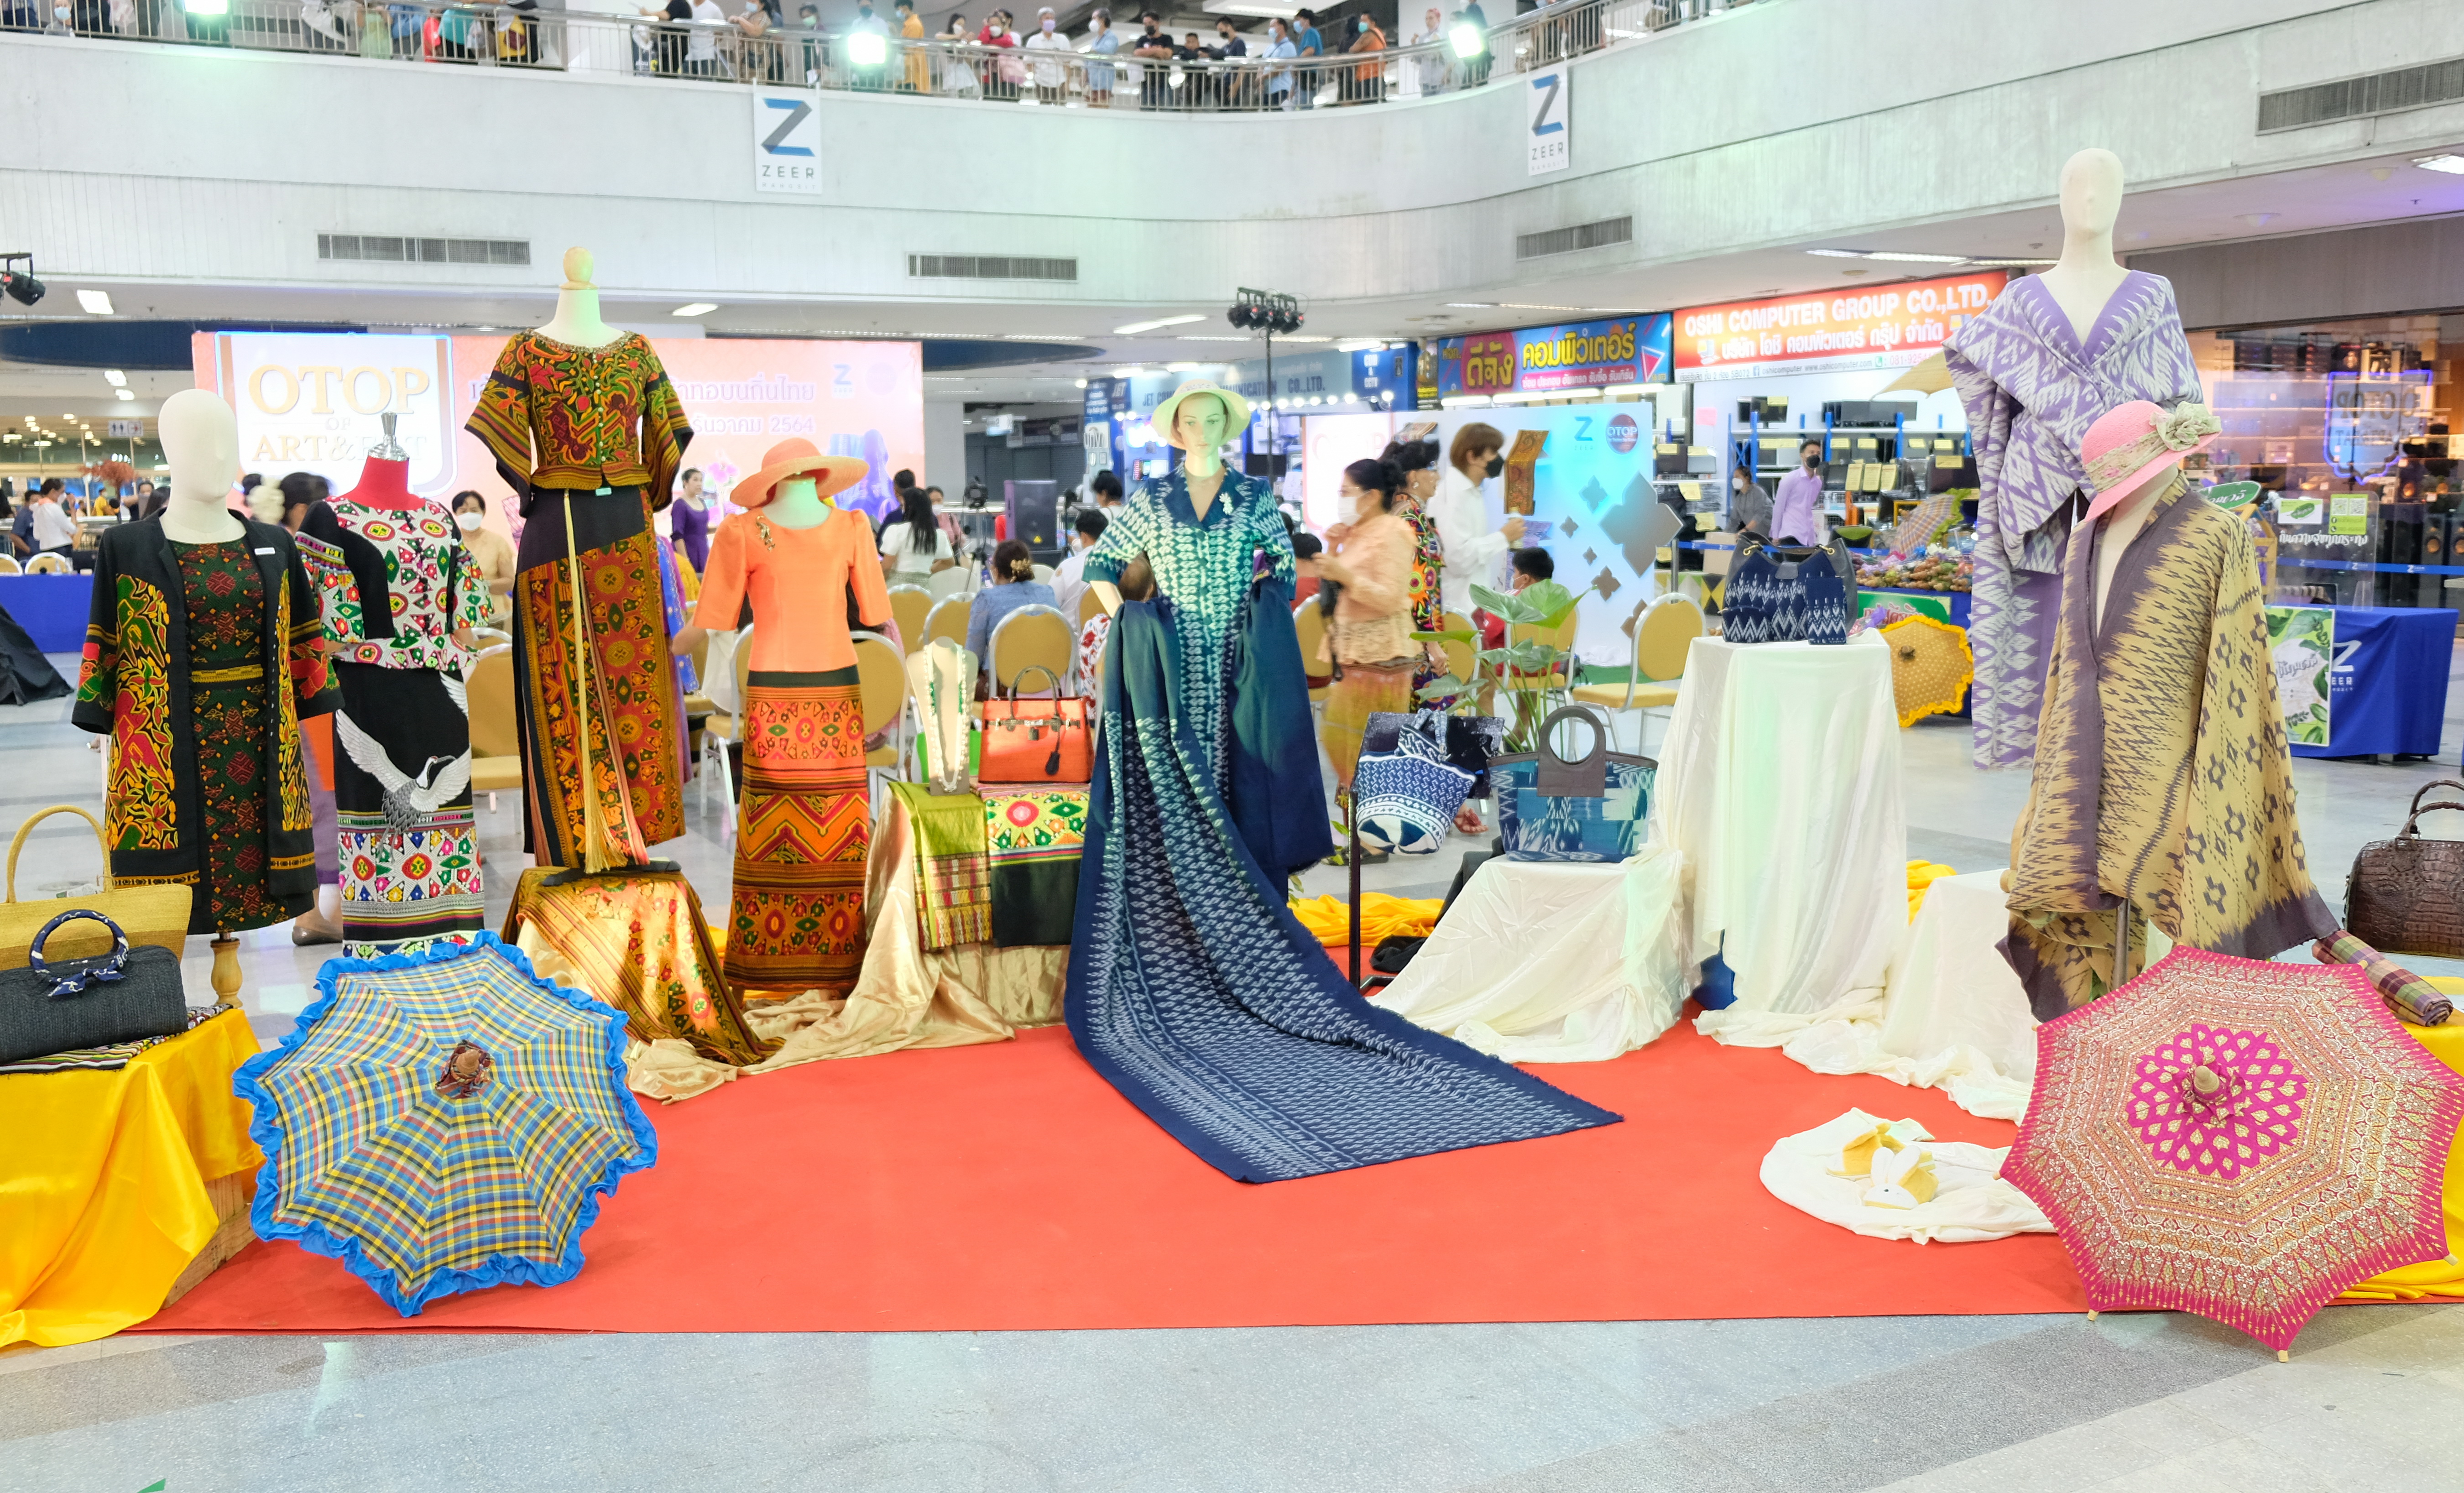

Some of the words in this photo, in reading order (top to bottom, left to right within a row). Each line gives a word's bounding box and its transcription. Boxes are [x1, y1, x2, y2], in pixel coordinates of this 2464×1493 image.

[1532, 142, 1563, 160] ZEER
[762, 165, 814, 179] ZEER
[1685, 312, 1723, 337] OSHI
[1728, 302, 1825, 333] COMPUTER
[1832, 292, 1900, 321] GROUP
[1522, 322, 1637, 369] คอมพิวเตอร์
[1467, 341, 1514, 386] ดีจัง
[1762, 365, 1802, 375] oshicomputer
[248, 364, 429, 414] OTOP
[325, 417, 351, 430] OF
[770, 416, 814, 433] 2564
[1607, 427, 1638, 437] OTOP
[2332, 677, 2353, 685] EER
